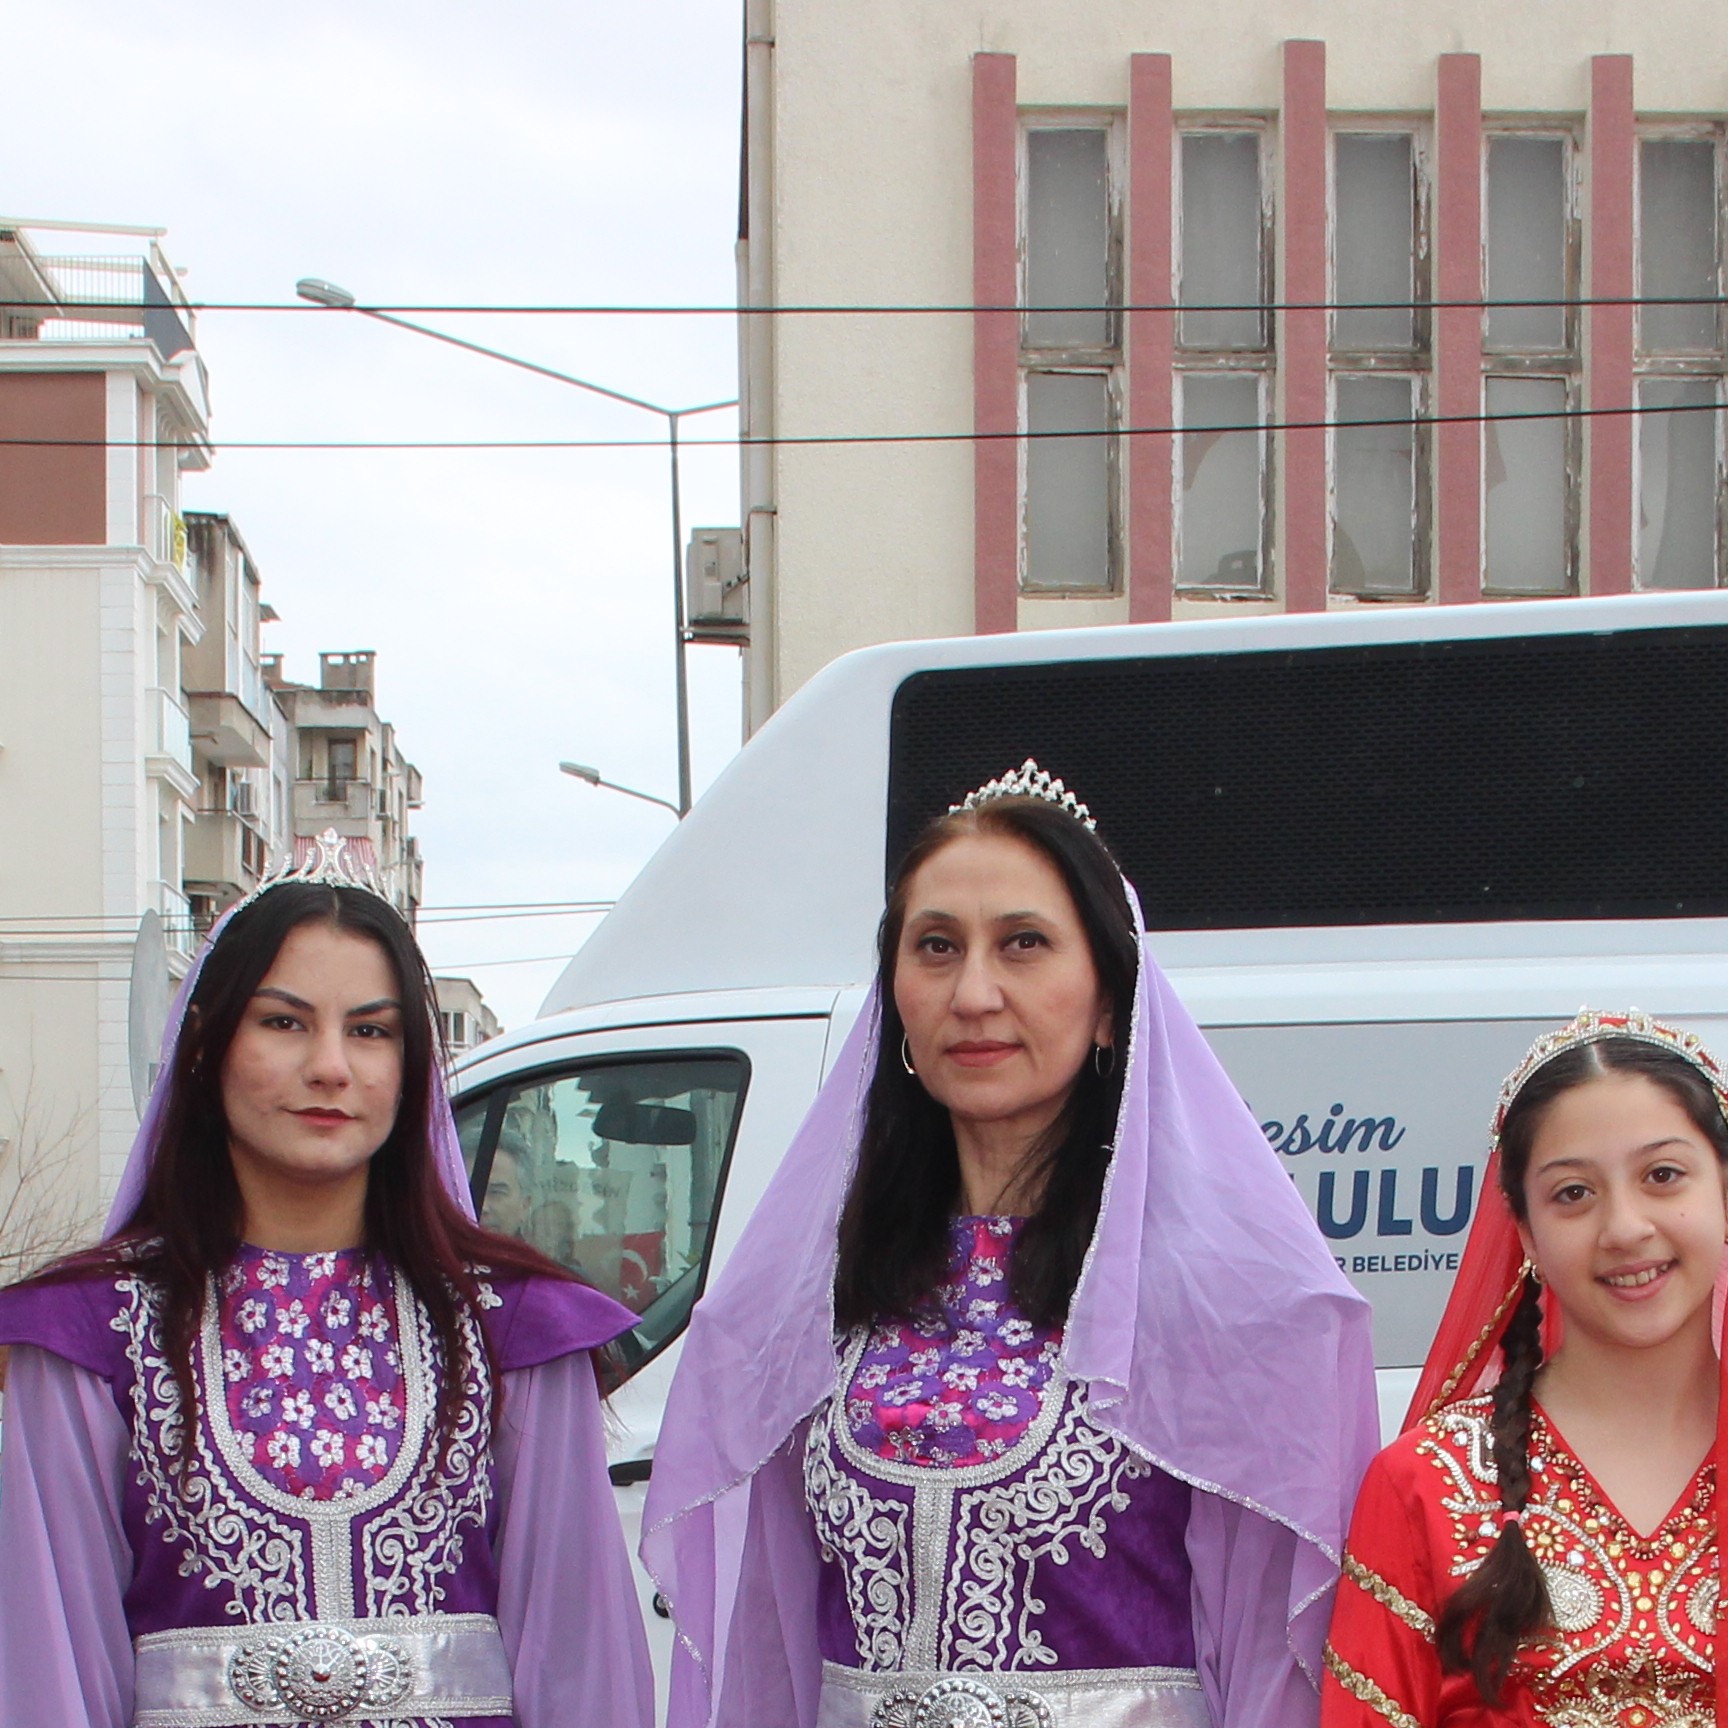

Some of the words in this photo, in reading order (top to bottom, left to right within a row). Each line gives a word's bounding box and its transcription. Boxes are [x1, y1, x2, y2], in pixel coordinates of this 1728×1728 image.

[1246, 1101, 1406, 1156] esim
[1289, 1166, 1474, 1240] ULU
[1352, 1249, 1459, 1273] BELEDİYE
